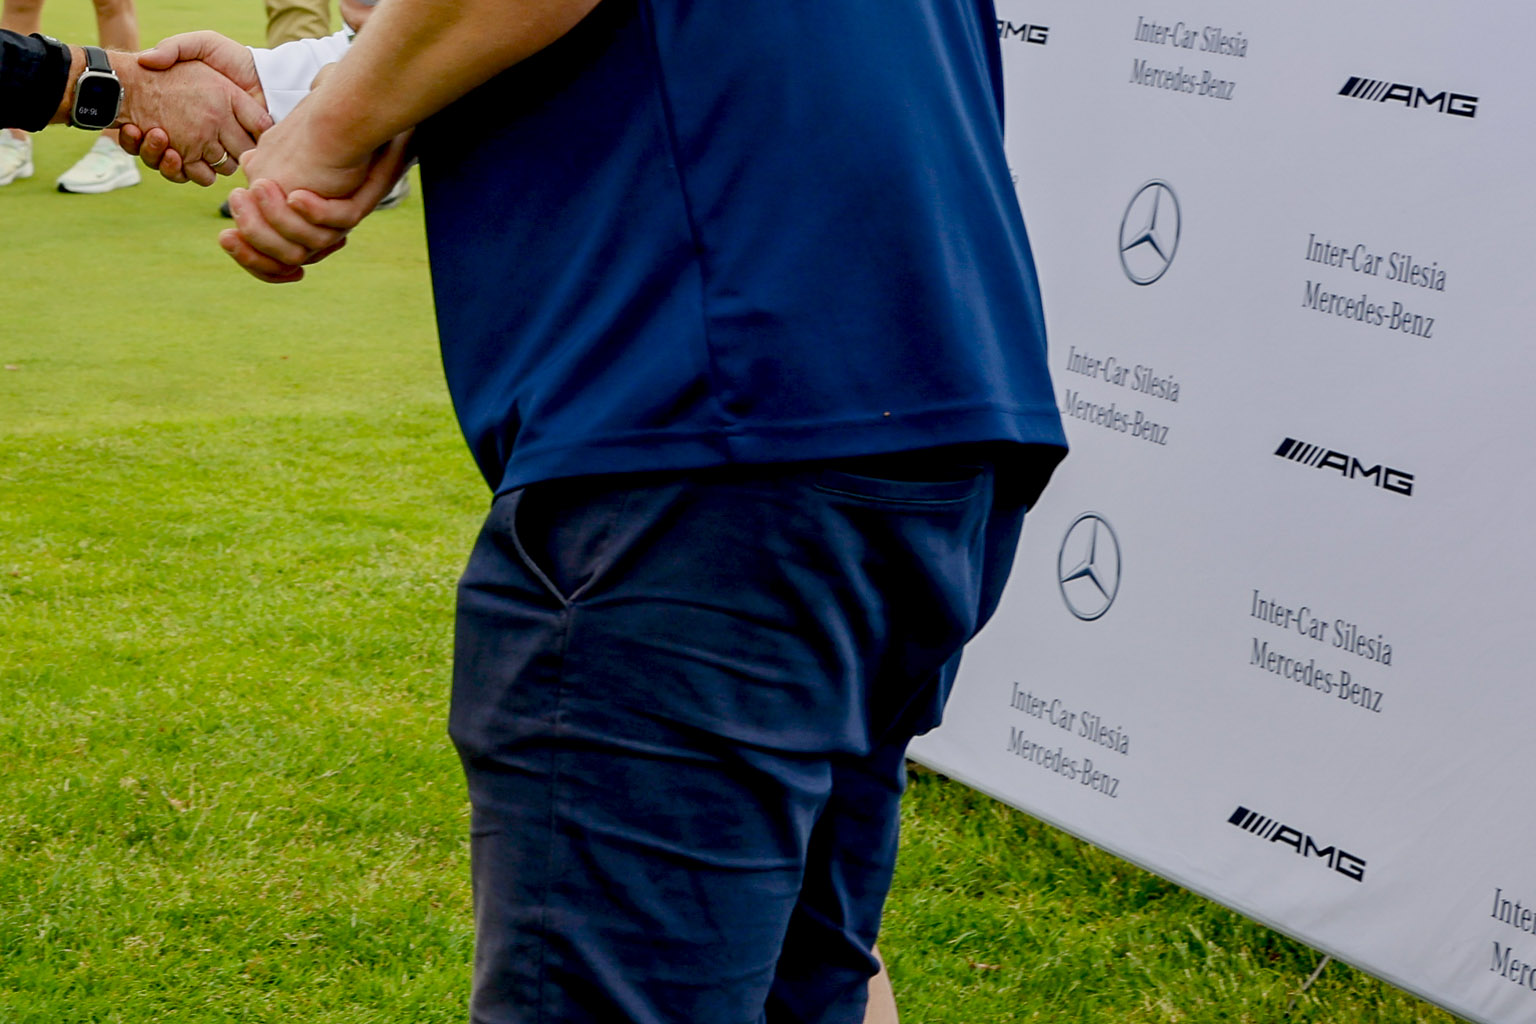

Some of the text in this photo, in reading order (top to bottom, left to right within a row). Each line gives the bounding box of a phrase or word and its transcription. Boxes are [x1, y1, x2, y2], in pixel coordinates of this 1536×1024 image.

[1134, 16, 1249, 59] Inter-Car Silesia
[1129, 58, 1237, 100] Mercedes-Benz
[1380, 81, 1480, 119] AMG
[1305, 233, 1447, 293] Inter-Car Silesia
[1302, 280, 1435, 339] Mercedes-Benz
[1066, 345, 1181, 403] Inter-Car Silesia
[1061, 389, 1170, 446] Mercedes-Benz
[1317, 448, 1416, 498] AMG
[1250, 589, 1393, 667] Inter-Car Silesia
[1249, 637, 1384, 714] Mercedes-Benz
[1009, 682, 1130, 756] Inter-Car Silesia
[1007, 727, 1121, 799] Mercedes-Benz
[1270, 823, 1368, 884] AMG
